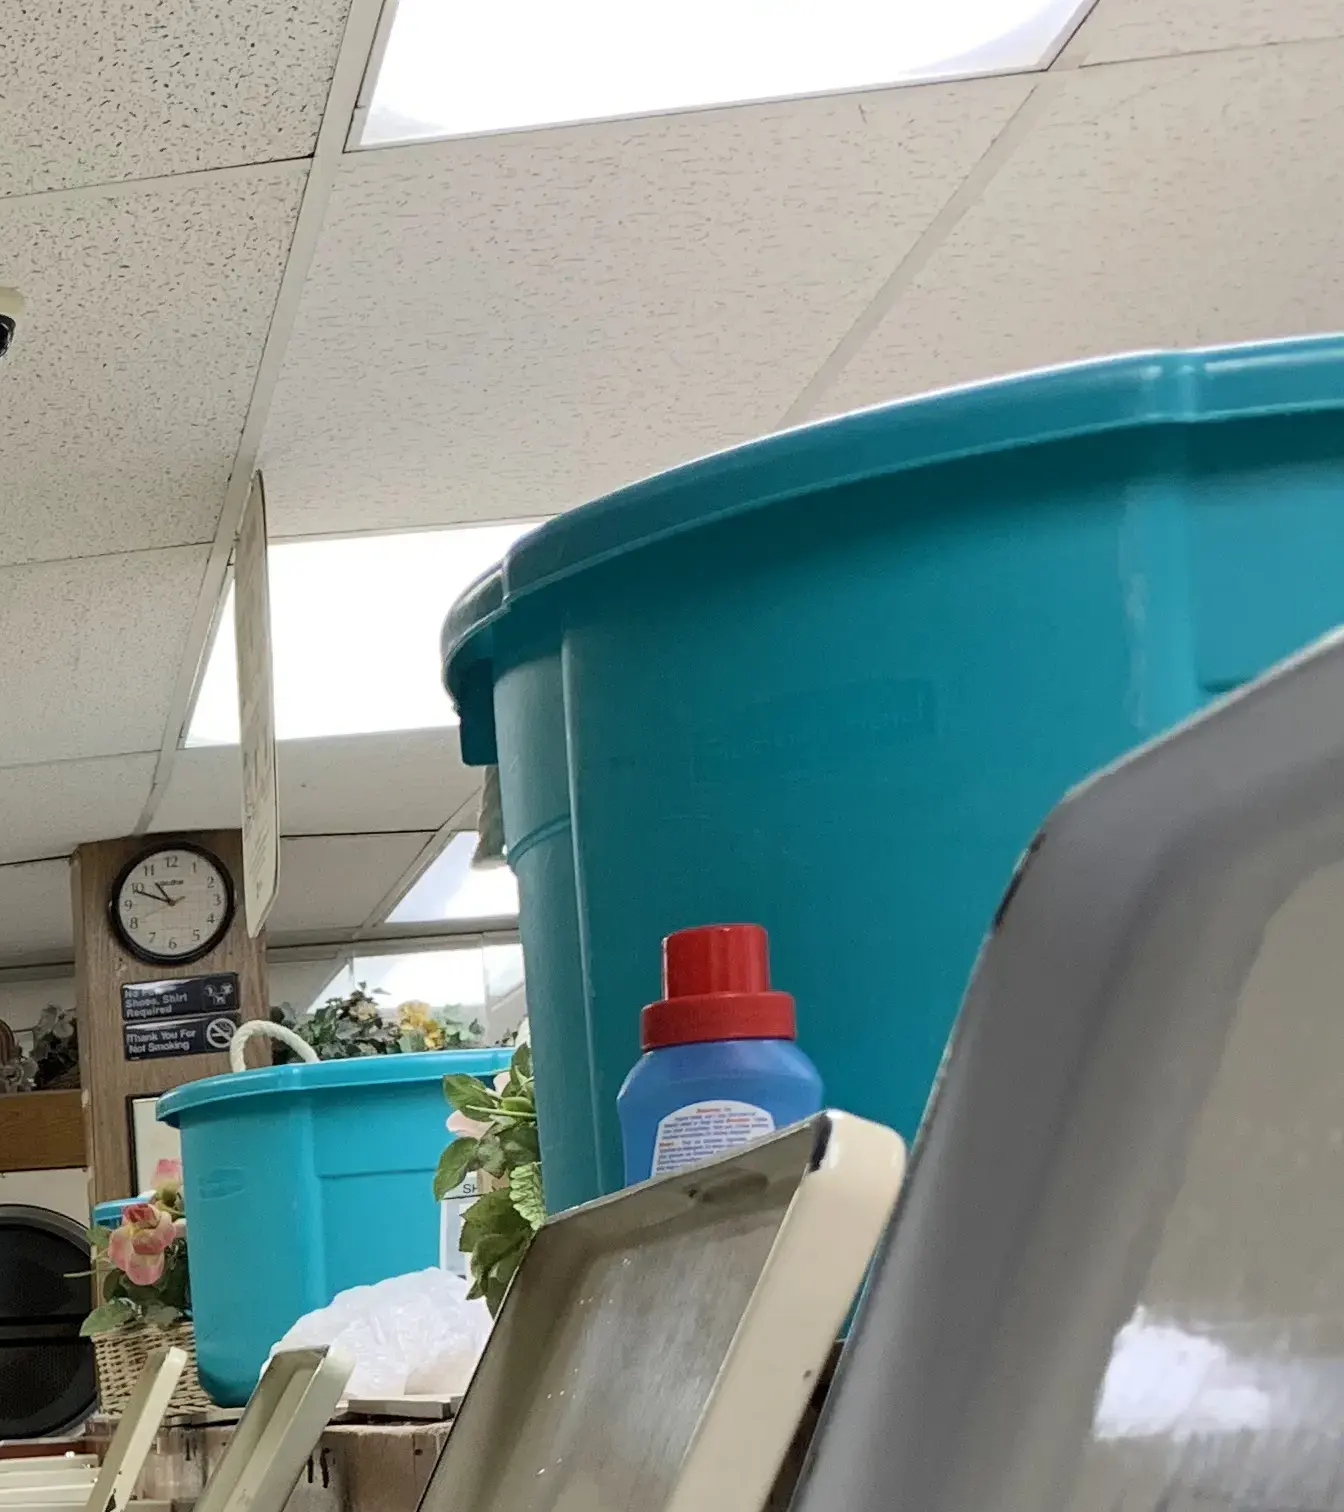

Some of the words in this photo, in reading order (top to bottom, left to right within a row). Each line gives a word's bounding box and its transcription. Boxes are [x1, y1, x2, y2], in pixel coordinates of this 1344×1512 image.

[165, 856, 179, 868] 12
[162, 993, 188, 1004] Shirt
[126, 1005, 172, 1018] Required
[127, 1032, 158, 1043] Thank
[161, 1031, 178, 1040] You
[180, 1029, 196, 1038] For
[129, 1044, 146, 1054] Not
[148, 1041, 190, 1053] Smoking
